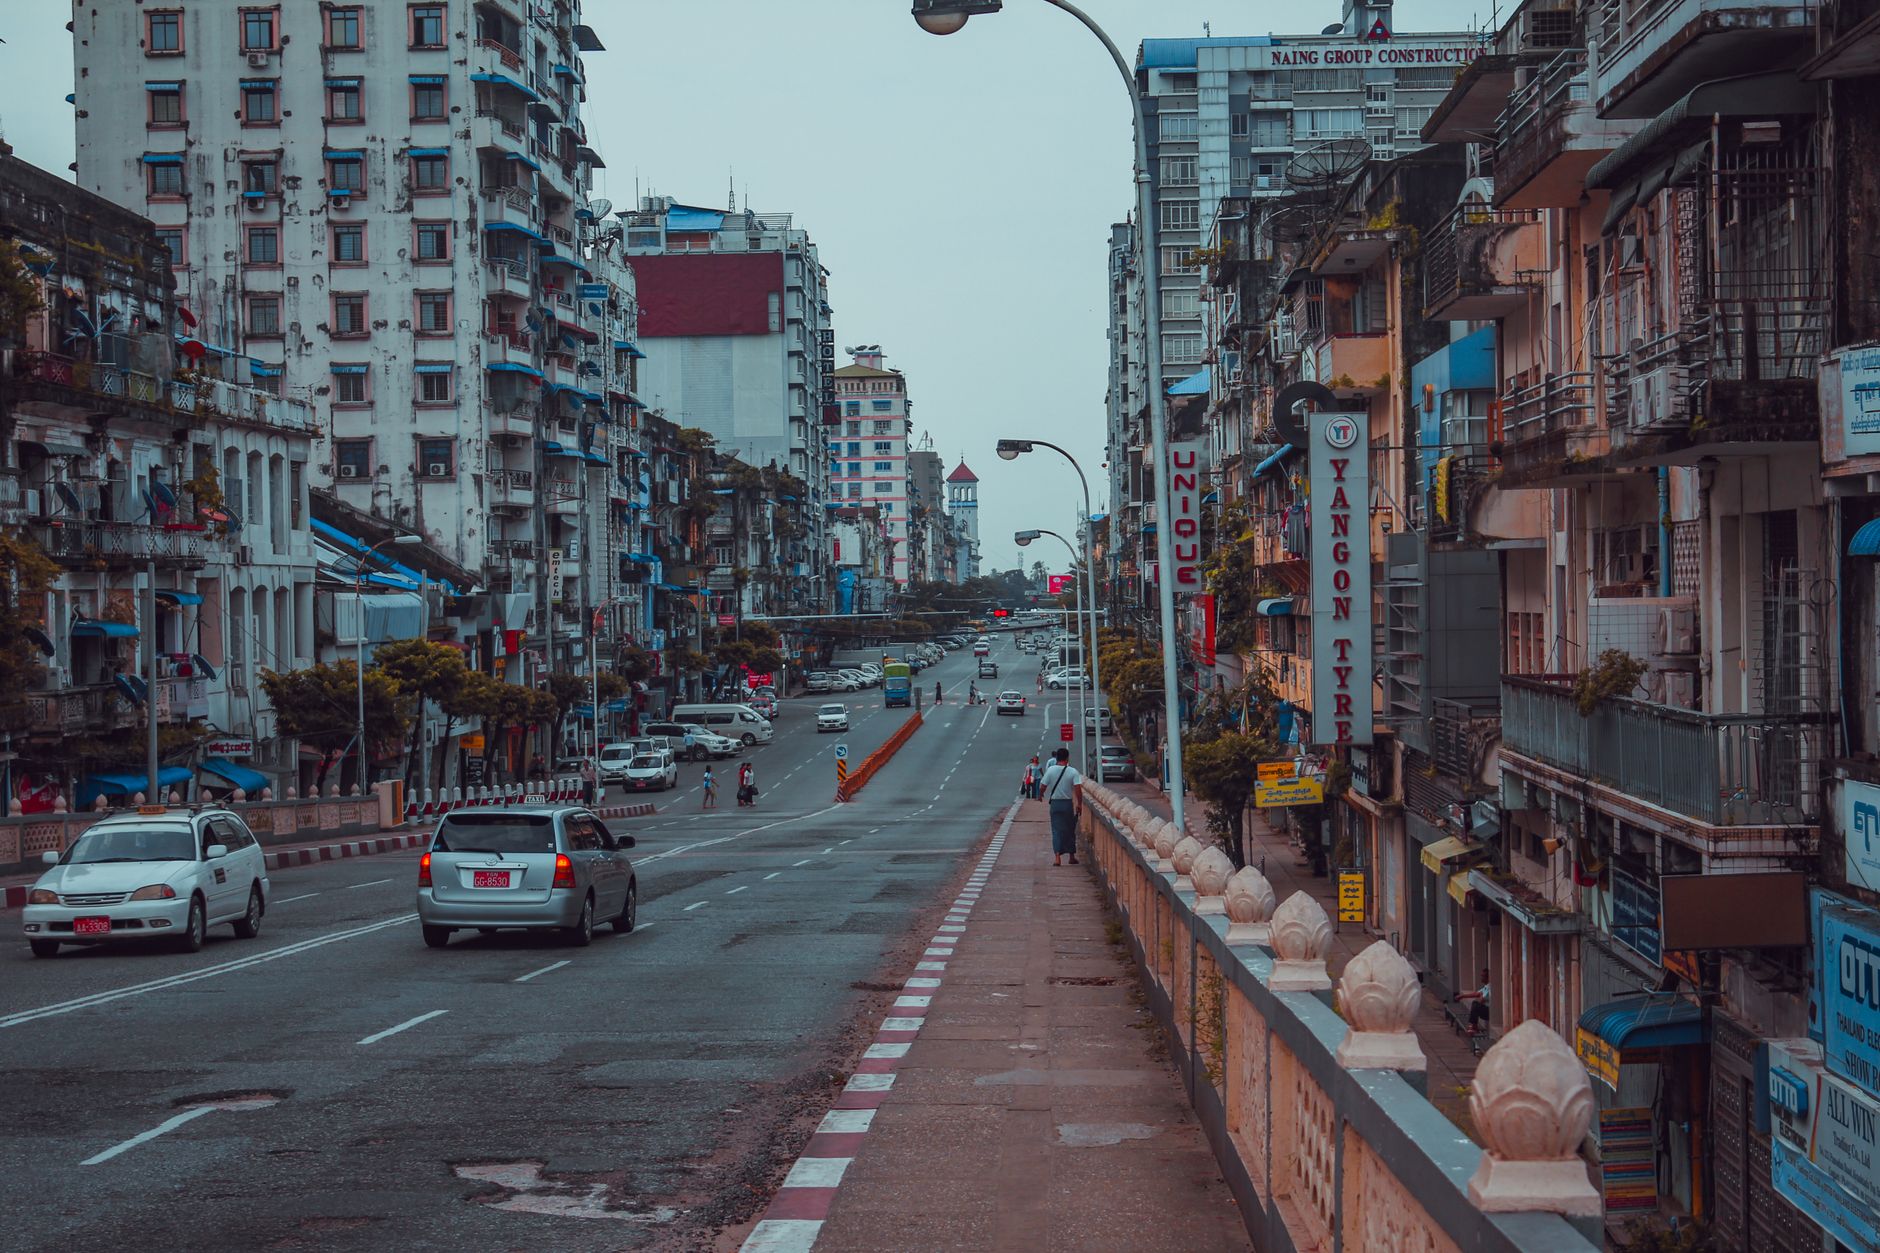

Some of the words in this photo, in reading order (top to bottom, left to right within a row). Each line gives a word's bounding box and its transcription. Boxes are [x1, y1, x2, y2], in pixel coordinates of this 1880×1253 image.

[1271, 50, 1319, 65] NAING
[1323, 49, 1373, 64] GROUP
[822, 331, 833, 403] HOTEL
[1333, 425, 1350, 440] YT
[1173, 450, 1197, 584] UNIQUE
[1329, 458, 1352, 620] YANGON
[551, 551, 561, 597] emtech
[1332, 638, 1353, 743] TYRE
[474, 876, 508, 887] GG-8530
[1836, 1011, 1865, 1044] THAILAND
[1844, 1048, 1872, 1087] SHOW
[1827, 1086, 1849, 1129] ALL
[1851, 1099, 1876, 1146] WIN
